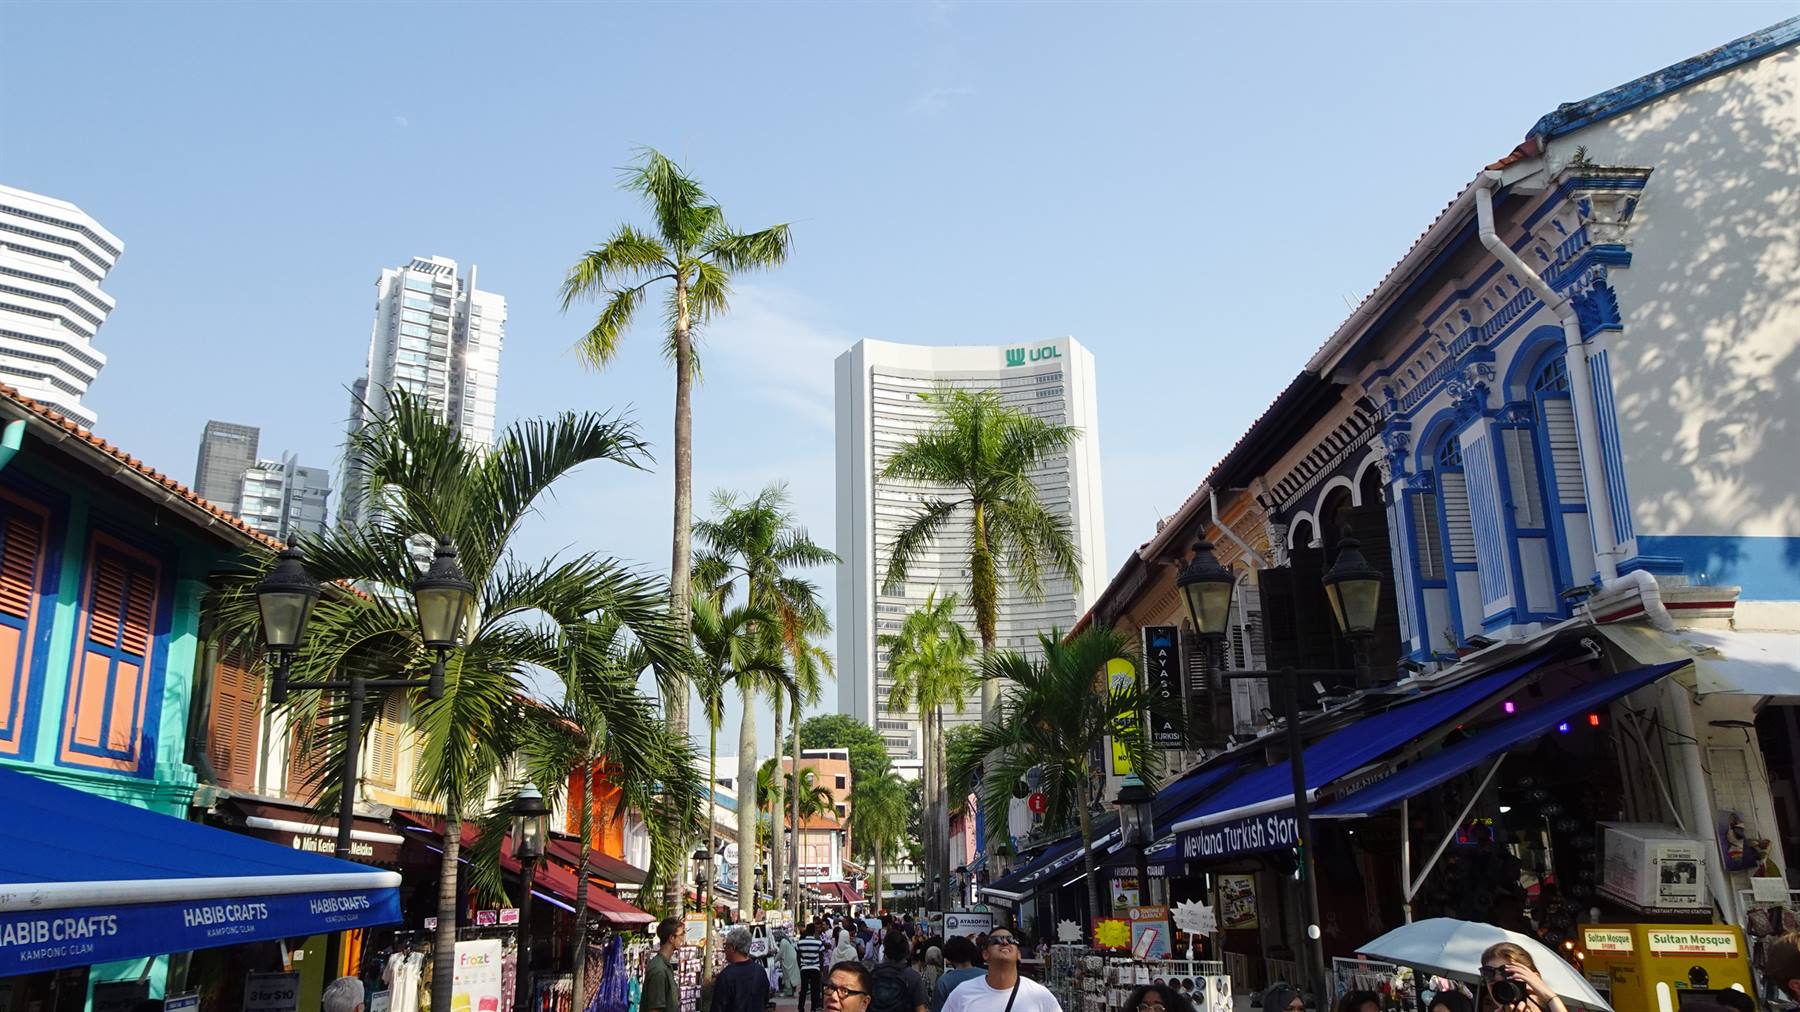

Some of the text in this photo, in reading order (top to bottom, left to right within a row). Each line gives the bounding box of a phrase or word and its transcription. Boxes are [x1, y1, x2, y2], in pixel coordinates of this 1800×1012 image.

[1030, 345, 1062, 361] UOL
[1158, 649, 1172, 730] AYASOA
[302, 837, 317, 851] Mini
[318, 839, 335, 853] Keria
[1184, 831, 1223, 858] Mevlana
[1224, 818, 1266, 852] Turkish
[310, 895, 370, 914] HABIB CRAFTS
[183, 903, 268, 927] HABIB CRAFTS
[0, 915, 118, 947] ABIB CRAFTS
[1588, 934, 1630, 944] Sultan Mosque
[1653, 934, 1731, 946] Sultan Mosque
[20, 943, 94, 961] KAMPONG GLAM
